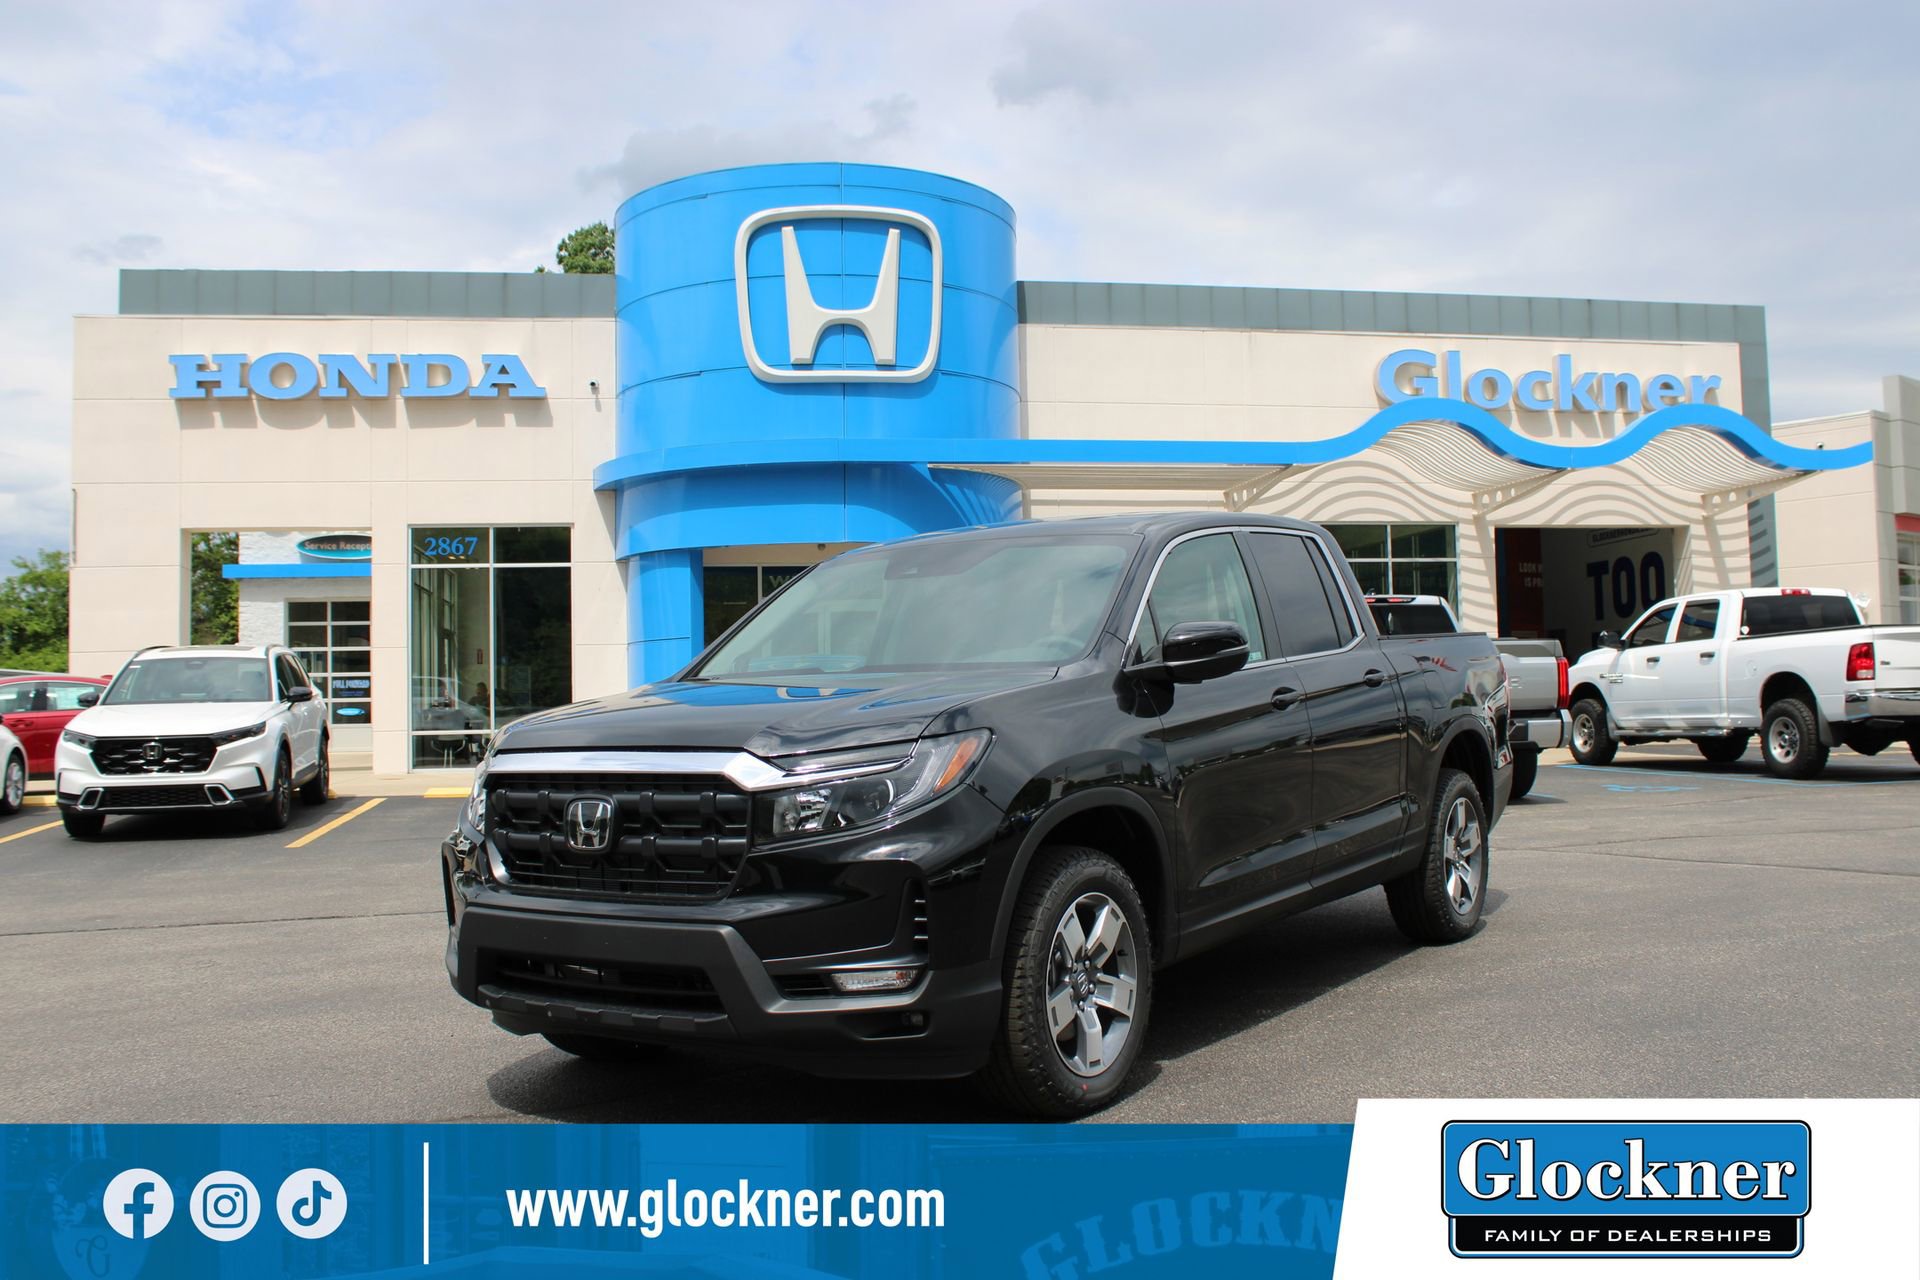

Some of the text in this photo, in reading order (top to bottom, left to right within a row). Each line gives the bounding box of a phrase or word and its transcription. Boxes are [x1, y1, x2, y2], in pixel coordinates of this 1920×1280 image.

[169, 352, 546, 399] HONDA
[1377, 348, 1722, 411] Glockner
[304, 541, 337, 550] Service
[424, 536, 478, 556] 2867
[1586, 551, 1665, 621] TOO
